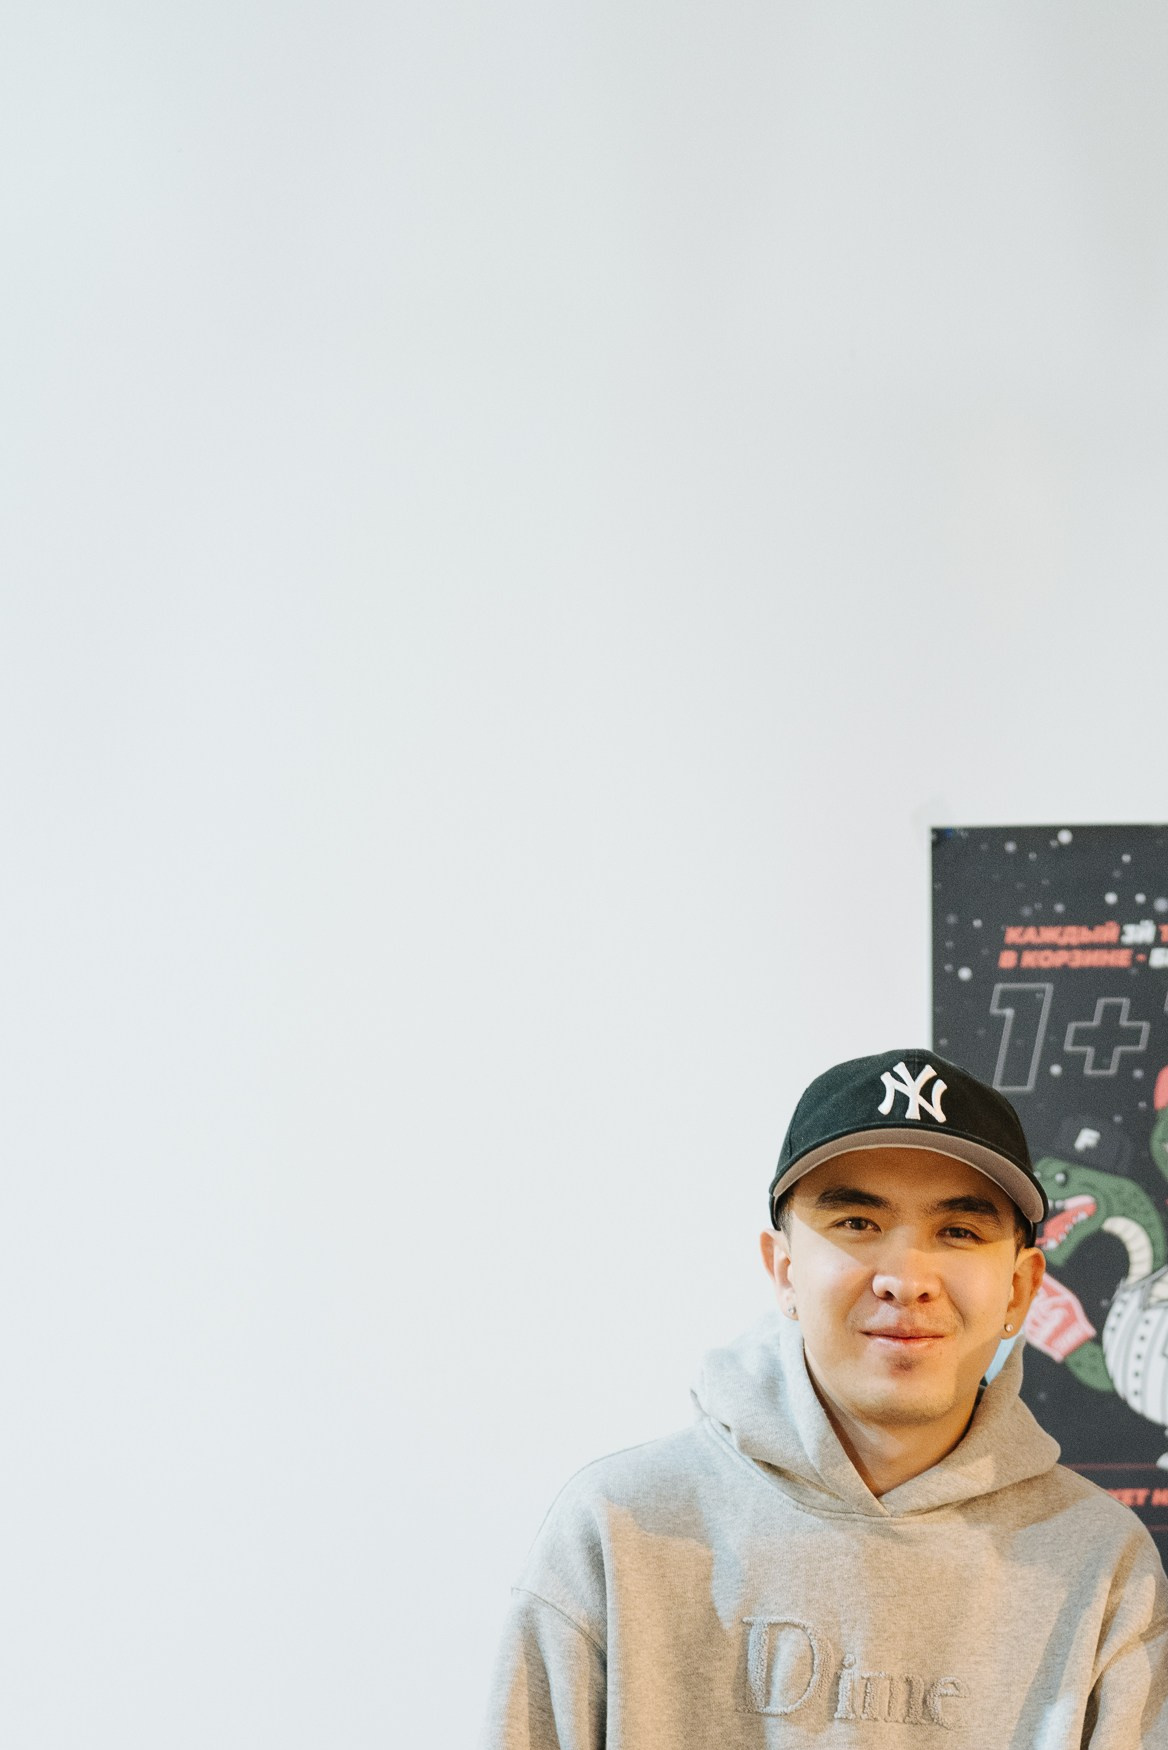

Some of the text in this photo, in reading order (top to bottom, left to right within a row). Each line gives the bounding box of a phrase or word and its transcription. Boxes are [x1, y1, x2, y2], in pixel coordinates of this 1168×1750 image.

[998, 949, 1017, 969] В
[877, 1061, 948, 1123] NY
[736, 1616, 970, 1731] Dime
